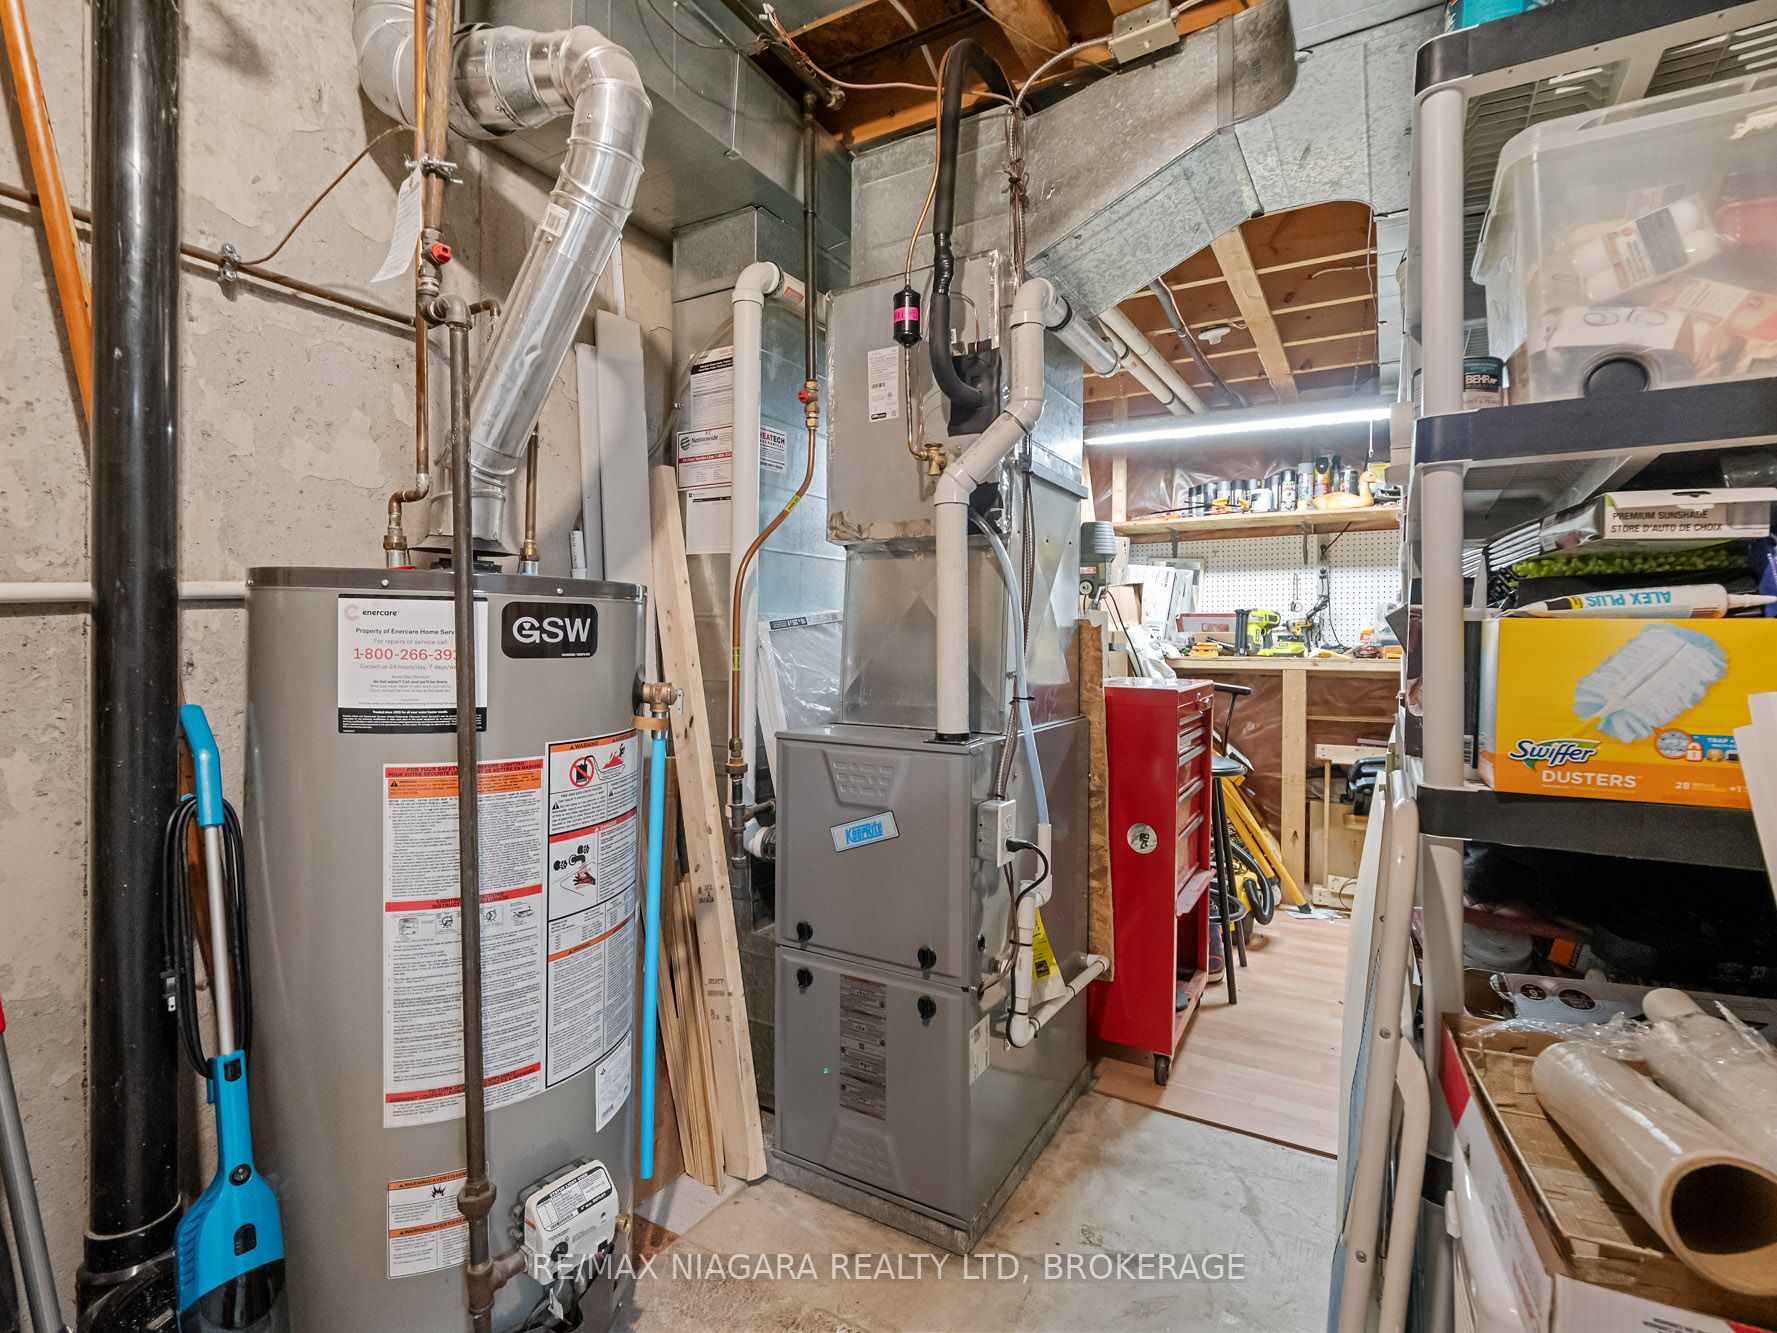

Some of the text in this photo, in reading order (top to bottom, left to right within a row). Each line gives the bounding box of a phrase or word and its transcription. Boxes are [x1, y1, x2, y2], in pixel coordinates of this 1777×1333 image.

[1466, 374, 1490, 384] BEHR
[1612, 510, 1709, 520] PREMIUM SUNSHADE
[1611, 523, 1723, 533] STORE D'AUTO DE CHOIX
[1585, 591, 1672, 607] ALEX PLUS
[362, 609, 398, 617] enercare
[512, 616, 591, 643] GSW
[575, 741, 599, 749] WARNING
[1509, 739, 1595, 766] Swiffer
[1541, 769, 1637, 788] DUSTERS
